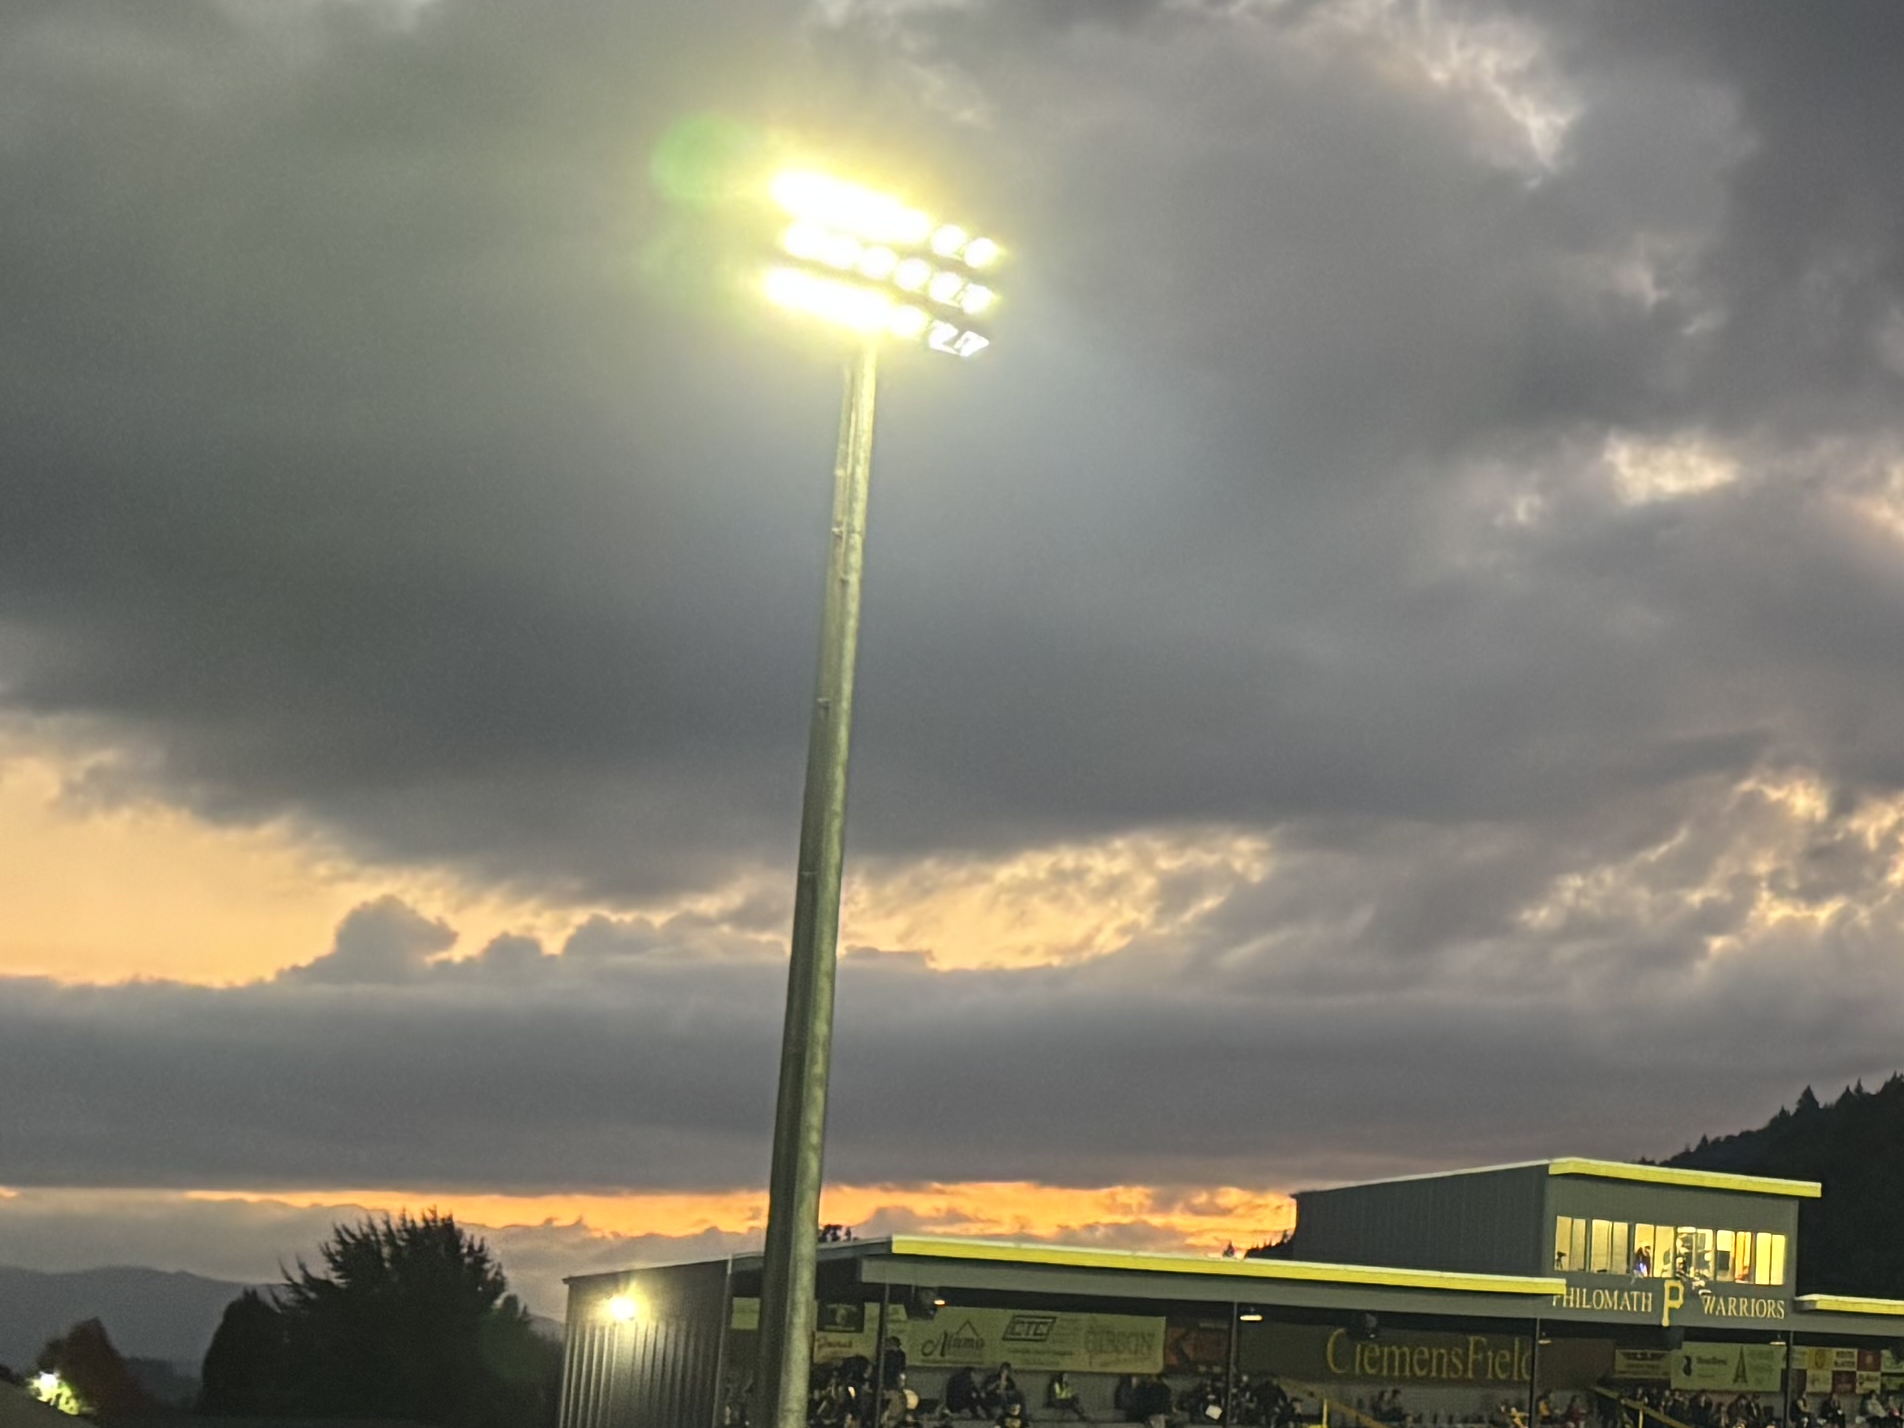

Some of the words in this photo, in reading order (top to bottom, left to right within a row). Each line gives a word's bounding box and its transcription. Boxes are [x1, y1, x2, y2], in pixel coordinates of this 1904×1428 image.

[1552, 1287, 1653, 1312] PHILOMATH
[1661, 1279, 1685, 1327] P
[1702, 1295, 1785, 1320] WARRIORS
